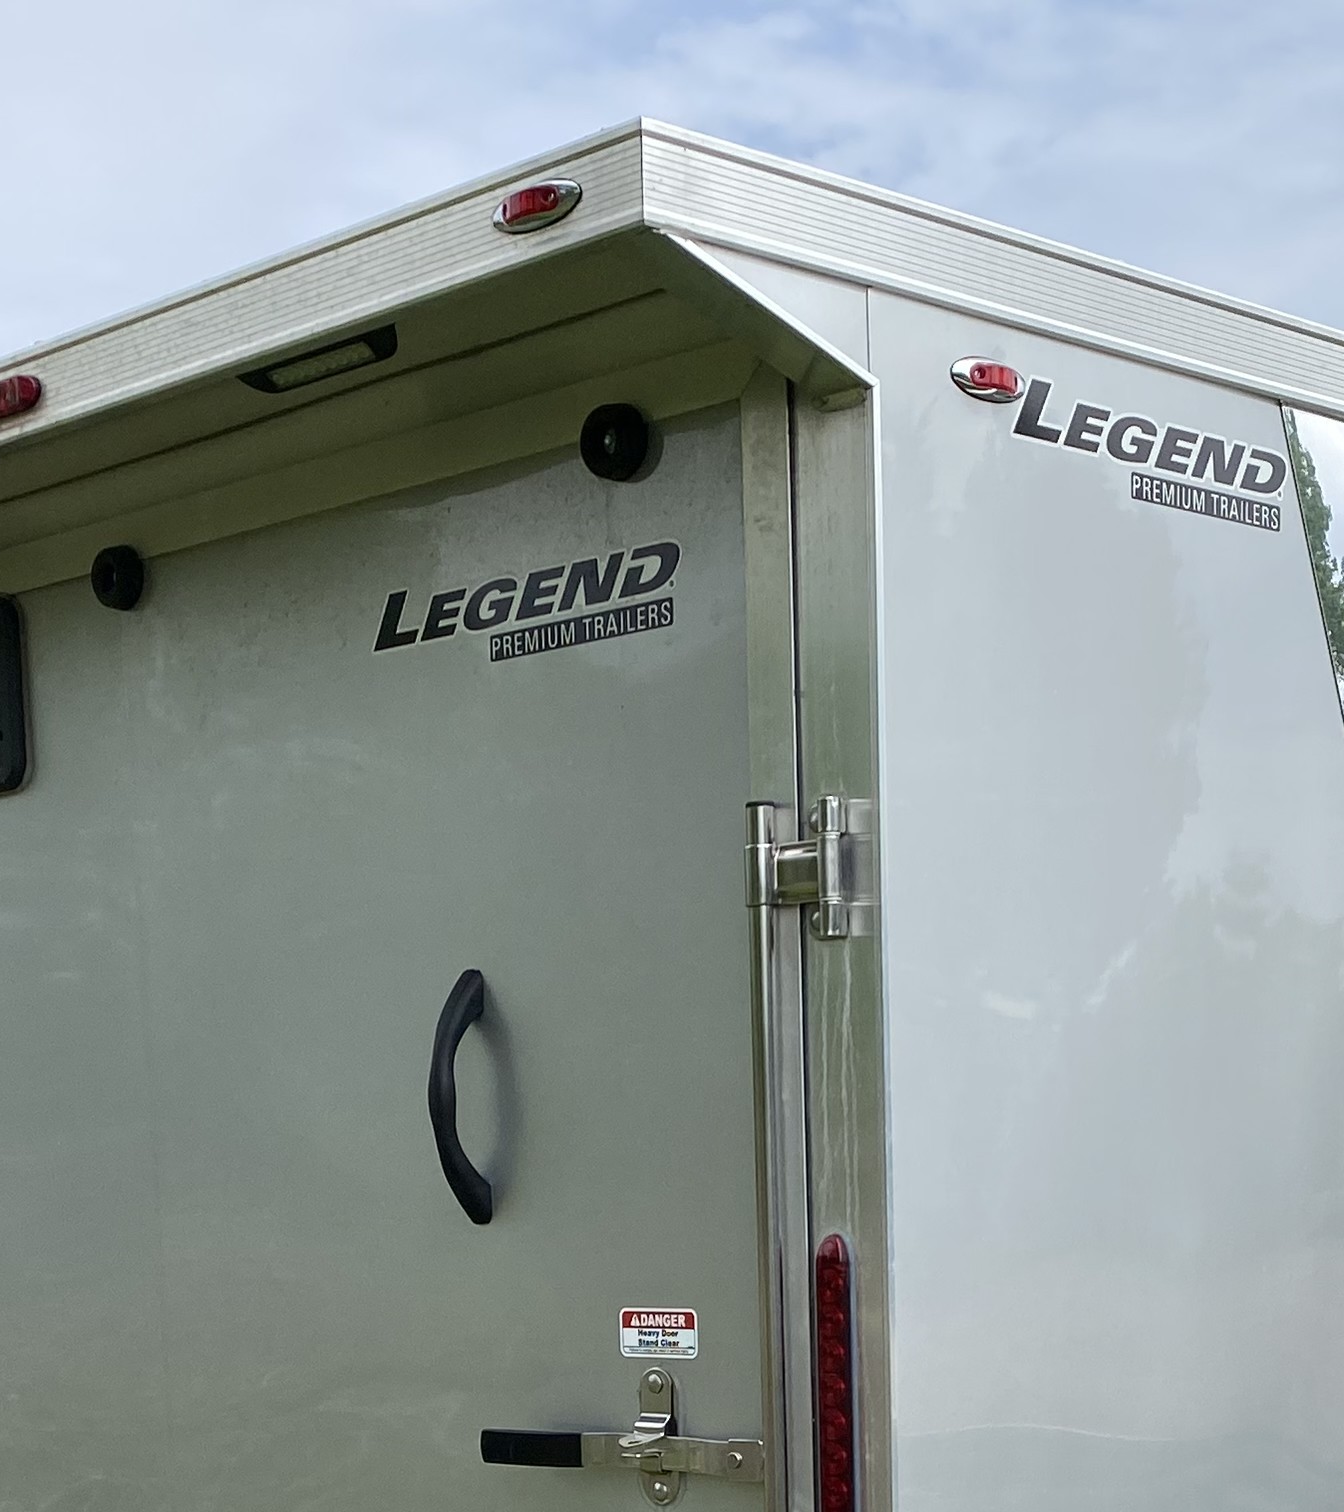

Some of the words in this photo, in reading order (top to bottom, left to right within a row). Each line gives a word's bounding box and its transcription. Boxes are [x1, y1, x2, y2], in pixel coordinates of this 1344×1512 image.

[1012, 379, 1287, 497] LEGEND
[1131, 474, 1206, 514] PREMIUM
[1210, 492, 1280, 532] TRAILERS
[372, 541, 682, 653] LEGEND
[490, 622, 577, 661] PREMIUM
[582, 602, 673, 642] TRAILERS
[637, 1328, 660, 1339] Heavy
[661, 1329, 679, 1338] Door
[637, 1338, 659, 1348] Stand
[660, 1339, 680, 1348] Clear
[640, 1313, 686, 1328] DANGER
